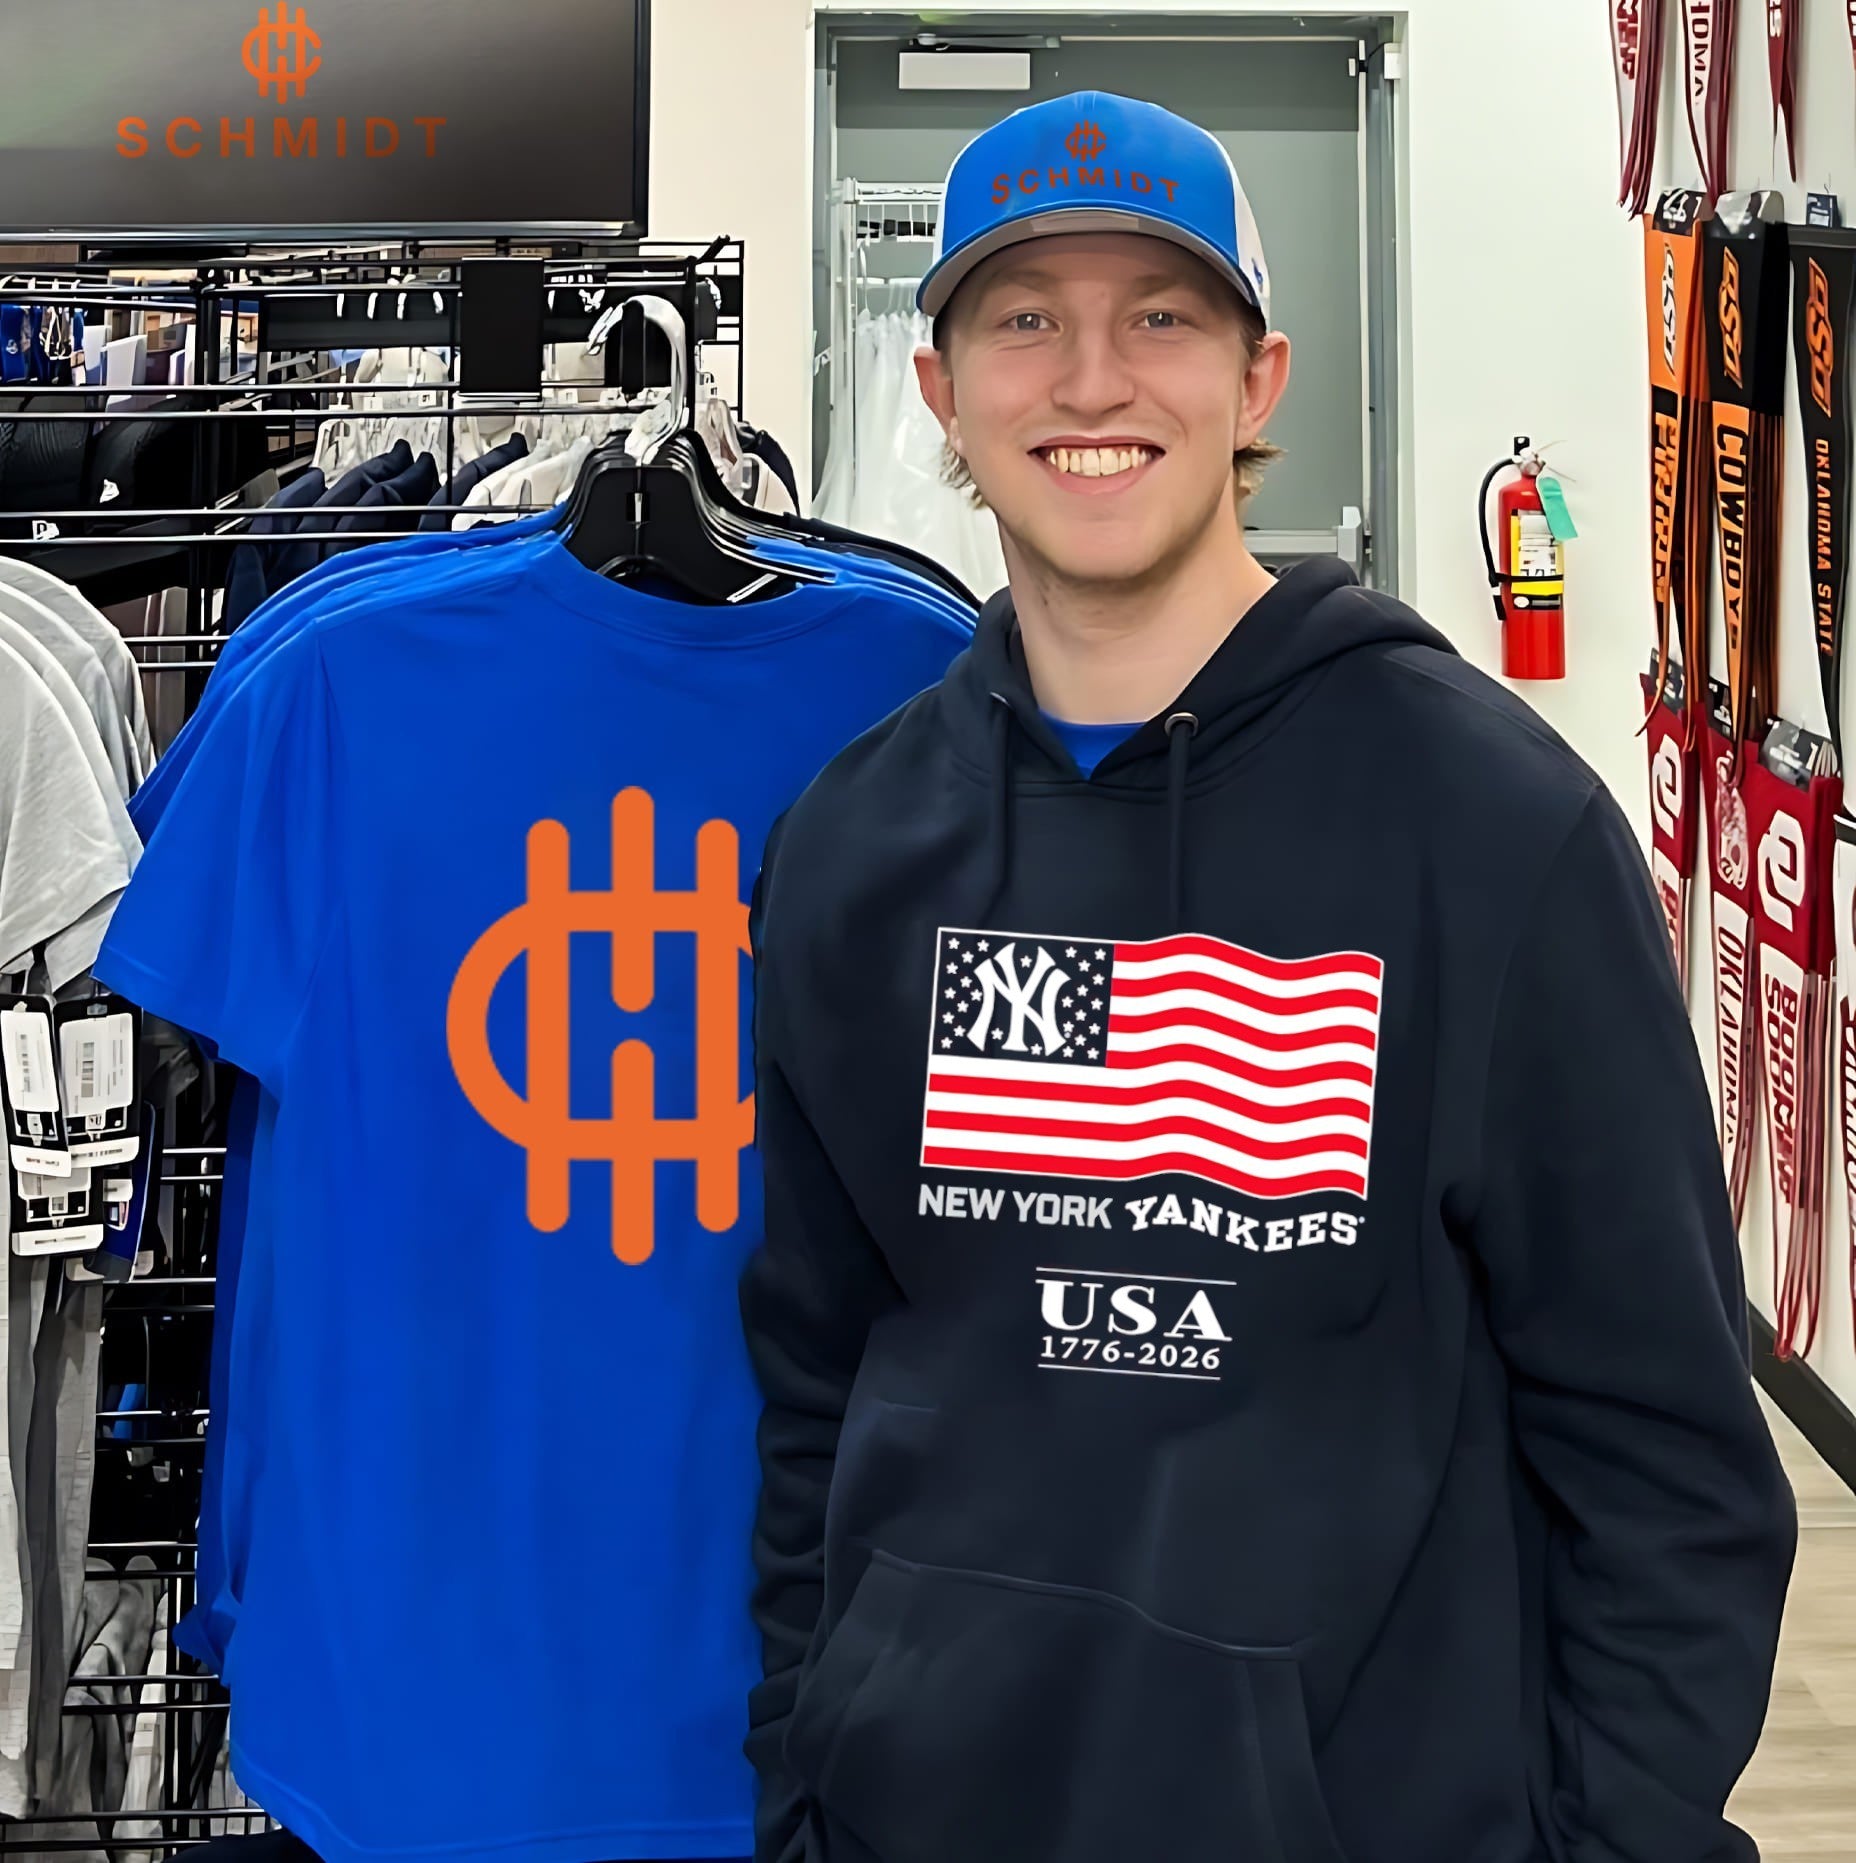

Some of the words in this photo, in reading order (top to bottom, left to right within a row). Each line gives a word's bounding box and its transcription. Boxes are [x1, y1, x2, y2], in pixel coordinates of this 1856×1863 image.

[116, 117, 447, 158] SCHMIDT
[992, 167, 1179, 204] SCHMIDT
[967, 942, 1071, 1057] NY
[918, 1184, 1005, 1221] NEW
[1012, 1191, 1113, 1230] YORK
[1125, 1194, 1359, 1253] YANKEES
[1035, 1279, 1233, 1342] USA
[1041, 1336, 1221, 1370] 1776-2026
